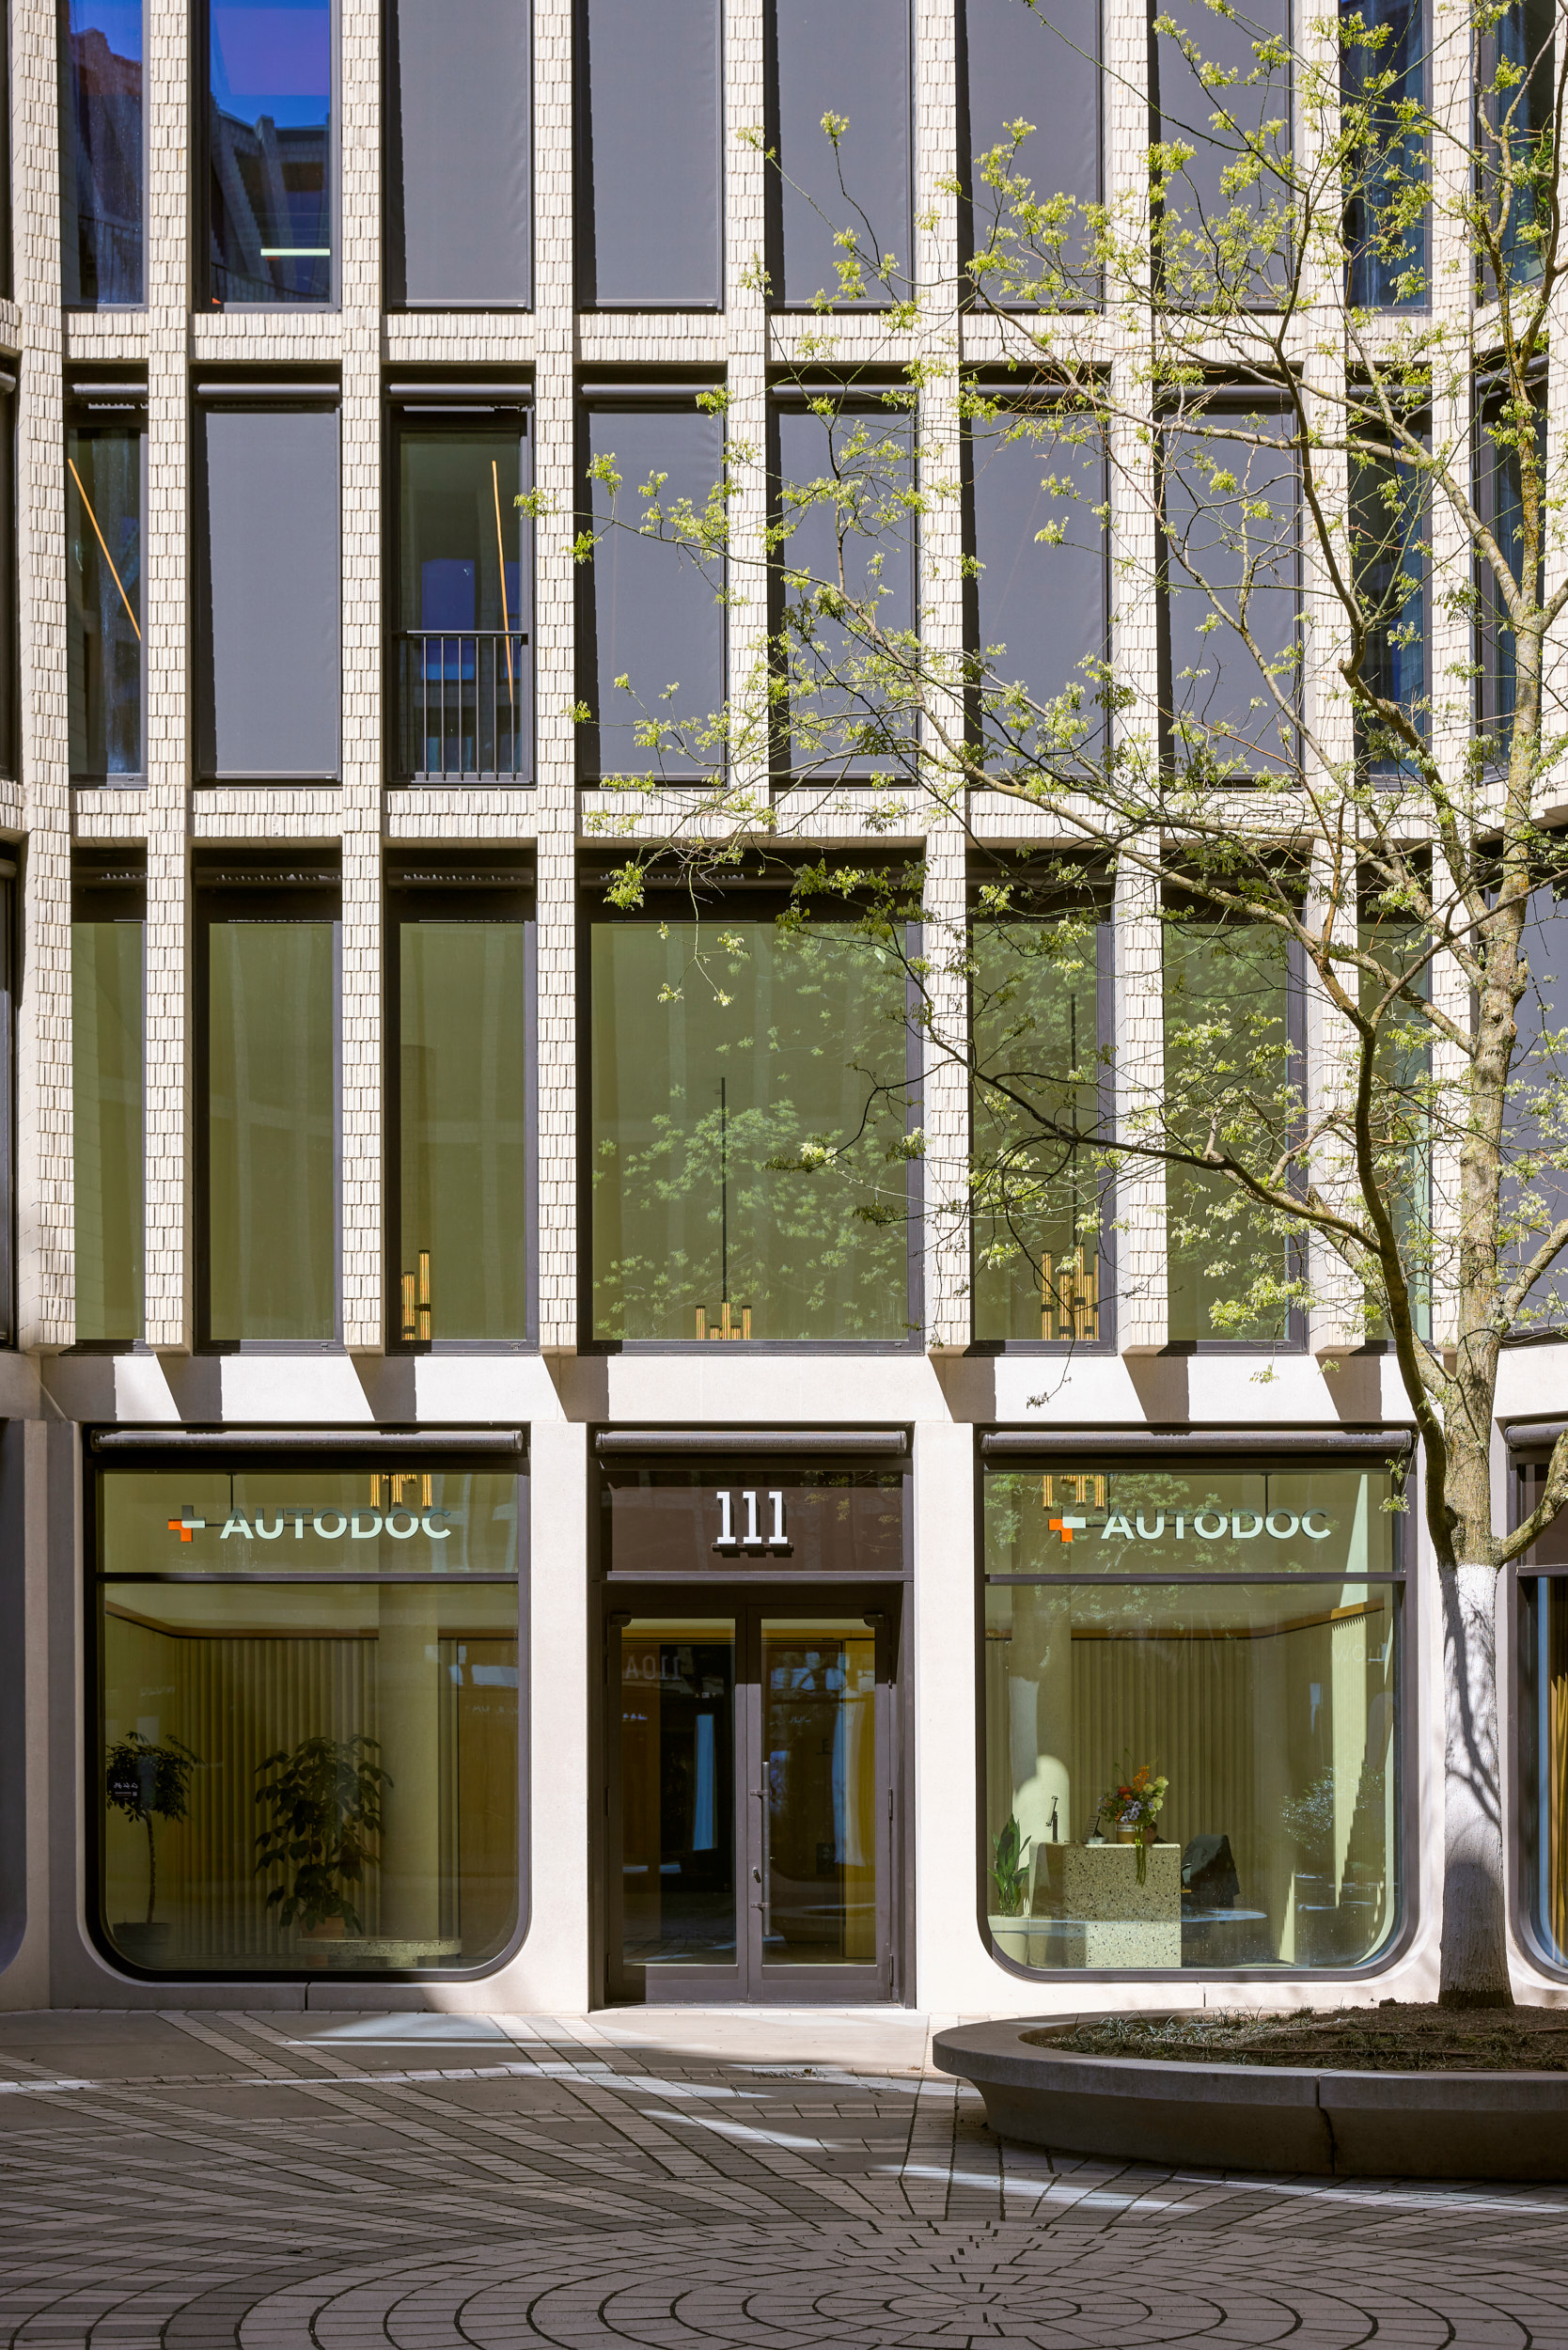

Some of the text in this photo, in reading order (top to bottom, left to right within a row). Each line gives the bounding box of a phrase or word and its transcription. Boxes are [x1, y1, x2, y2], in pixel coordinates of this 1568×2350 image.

[220, 1508, 451, 1539] AUTODOC
[716, 1492, 788, 1544] 111
[1101, 1508, 1331, 1539] AUTODOC
